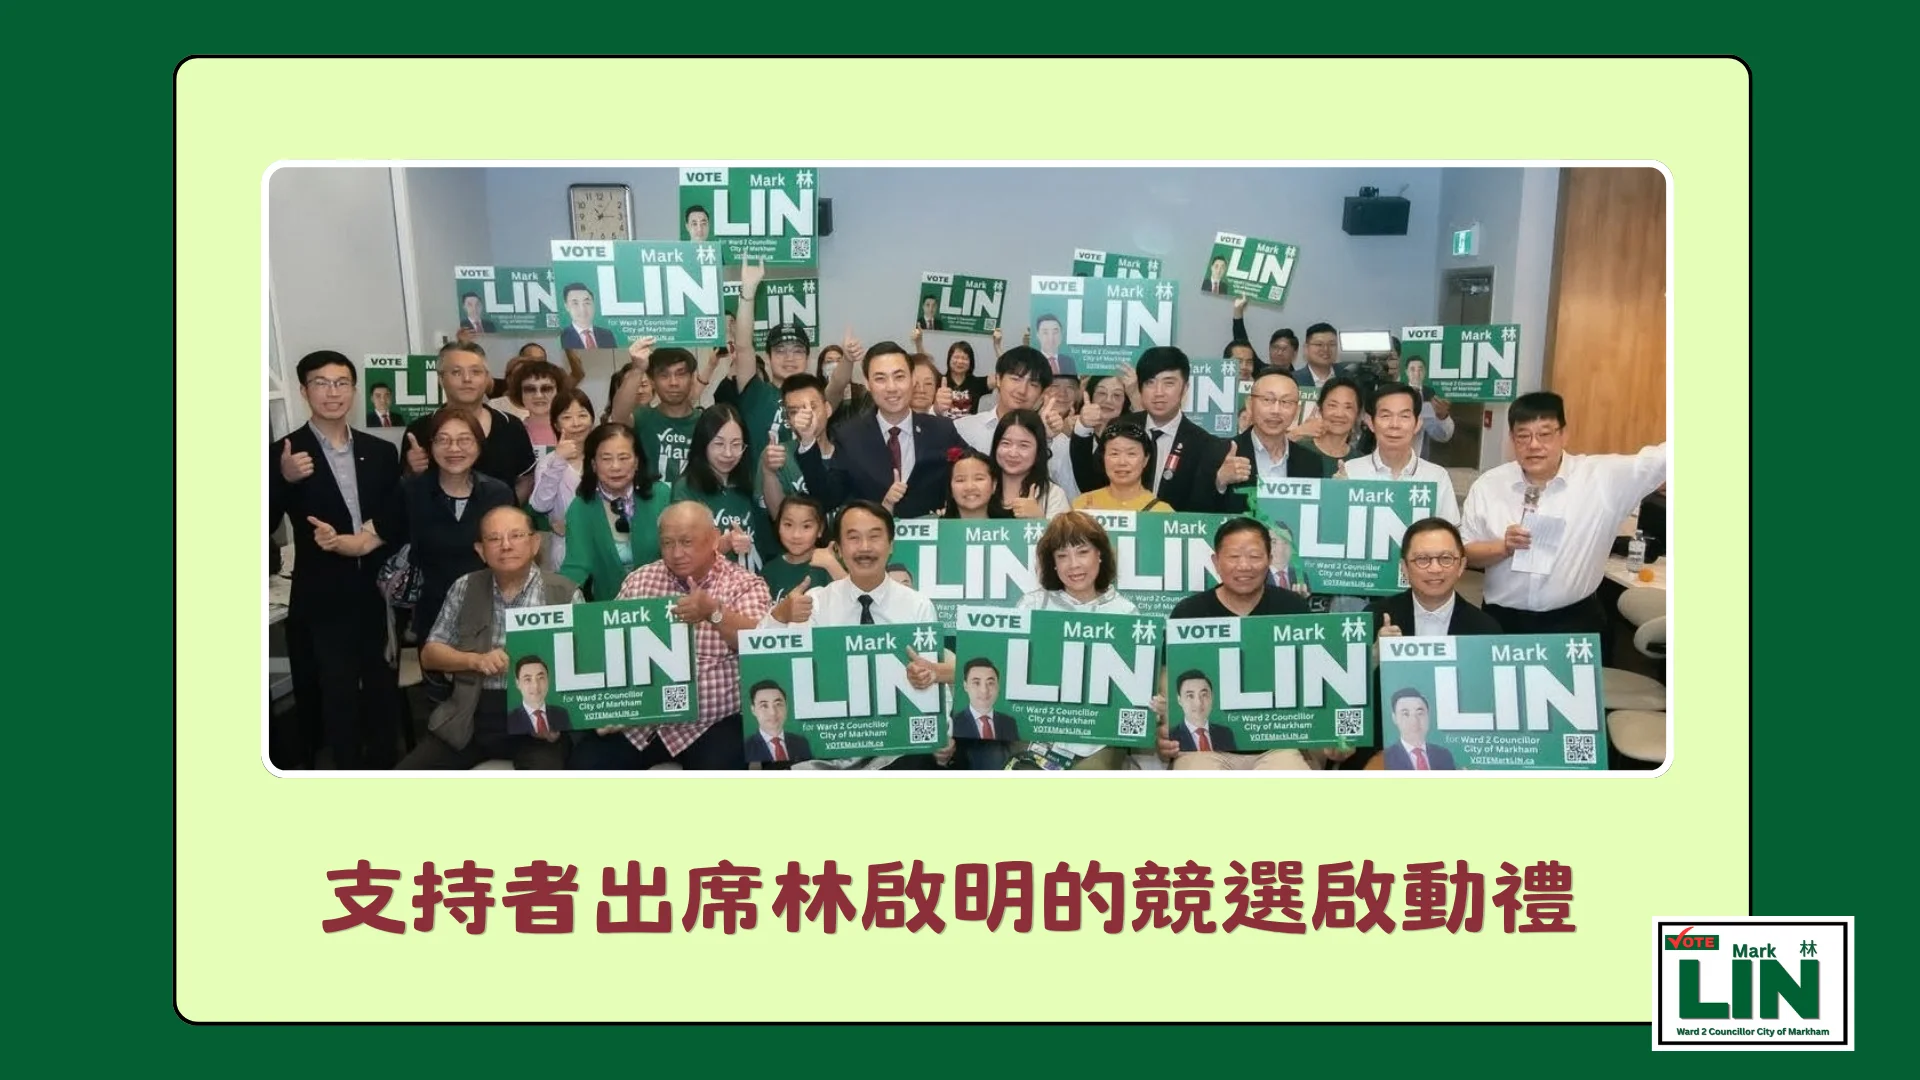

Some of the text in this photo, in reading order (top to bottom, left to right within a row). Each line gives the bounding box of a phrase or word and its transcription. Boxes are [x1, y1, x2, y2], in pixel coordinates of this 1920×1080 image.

[686, 173, 722, 182] VOTE
[750, 170, 813, 188] Mark 林
[714, 189, 813, 236] LIN
[1220, 235, 1241, 245] VOTE
[560, 246, 607, 257] VOTE
[641, 245, 716, 264] Mark 林
[1257, 243, 1278, 254] Mark
[1079, 251, 1101, 261] VOTE
[1119, 258, 1159, 272] Mark 林
[1227, 248, 1293, 286] LIN
[511, 272, 538, 280] Mark
[927, 275, 948, 283] VOTE
[597, 265, 719, 316] LIN
[767, 280, 815, 294] Mark 林
[965, 281, 986, 289] Mark
[1039, 281, 1077, 291] VOTE
[1107, 282, 1173, 300] Mark 林
[484, 281, 558, 312] LIN
[940, 287, 1002, 318] LIN
[1067, 299, 1172, 347] LIN
[1408, 330, 1437, 338] VOTE
[1462, 327, 1516, 341] Mark 林
[1429, 342, 1516, 378] LIN
[1221, 361, 1236, 376] 林
[395, 371, 441, 404] LI
[1267, 483, 1312, 495] VOTE
[1350, 485, 1431, 507] Mark 林
[1098, 515, 1128, 528] OTE
[1164, 520, 1207, 535] Mark
[896, 525, 930, 536] OTE
[966, 522, 1044, 543] Mark 林
[1299, 504, 1430, 560] LIN
[919, 545, 1040, 599] LIN
[1317, 562, 1335, 570] Ward
[1138, 603, 1152, 611] City
[515, 611, 564, 626] VOTE
[603, 607, 650, 625] Mark
[939, 612, 952, 620] City
[968, 613, 1021, 629] VOTE
[1064, 620, 1156, 644] Mark 林
[1177, 624, 1231, 639] VOTE
[1274, 616, 1366, 642] Mark 林
[749, 635, 803, 649] VOTE
[846, 626, 937, 651] Mark 林
[554, 623, 691, 691] LIN
[1391, 643, 1447, 657] VOTE
[1492, 638, 1593, 663] Mark 林
[1006, 639, 1155, 707] LIN
[1219, 643, 1367, 710] LIN
[792, 652, 940, 719] LIN
[563, 695, 574, 703] for
[576, 694, 596, 702] Ward
[604, 691, 644, 700] Councillor
[1434, 665, 1599, 731] LIN
[579, 702, 597, 711] City
[1012, 704, 1099, 717] for Ward 2 Councillor
[1029, 714, 1096, 725] City of Markham
[1227, 714, 1240, 722] for
[1242, 713, 1263, 722] Ward
[1271, 713, 1314, 721] Councillor
[803, 721, 889, 731] for Ward 2 Councillor
[1244, 722, 1312, 731] City of Markham
[820, 730, 887, 740] City of Markham
[1446, 735, 1540, 744] for Ward 2 Councillor
[1464, 745, 1538, 754] City of Markham
